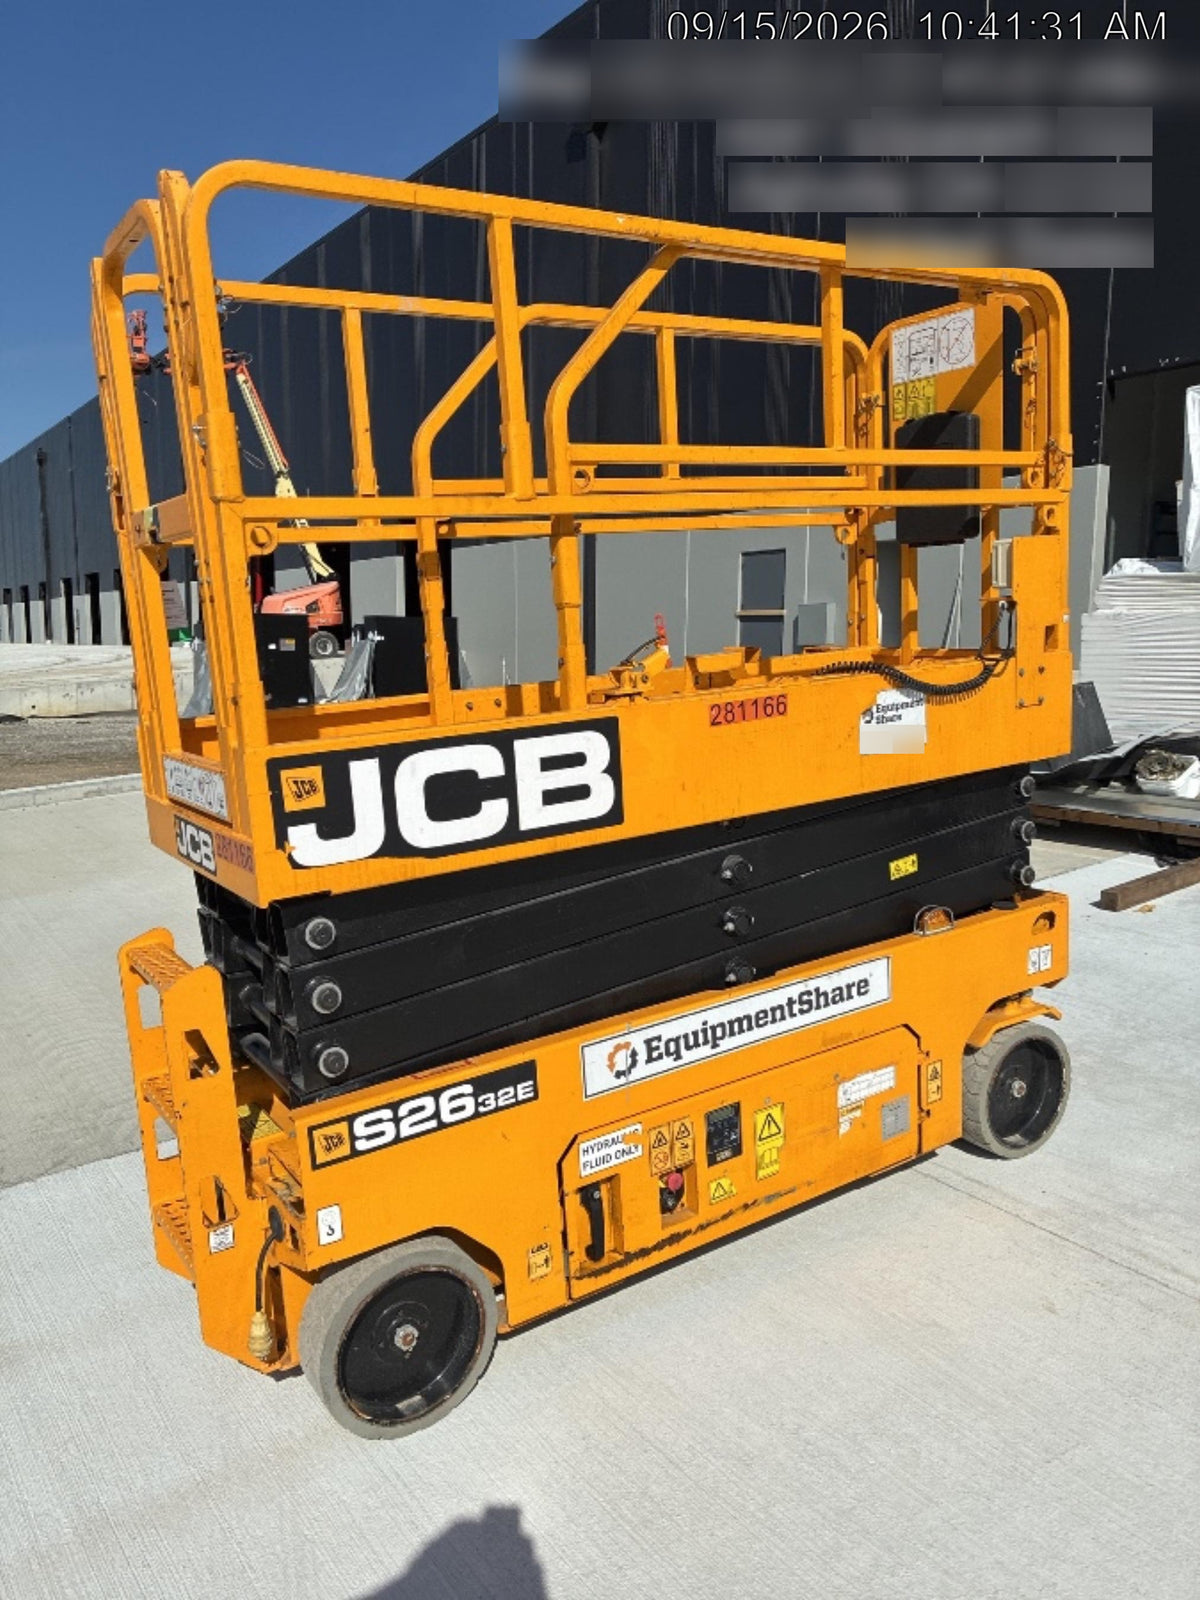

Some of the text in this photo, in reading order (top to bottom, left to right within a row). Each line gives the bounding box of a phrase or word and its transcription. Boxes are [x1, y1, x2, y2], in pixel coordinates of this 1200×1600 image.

[709, 694, 787, 727] 281166
[287, 729, 616, 867] JCB
[292, 779, 318, 800] JCB
[176, 818, 216, 874] JCB
[642, 976, 871, 1066] EquipmentShare
[582, 1144, 640, 1172] FLUID ONLY
